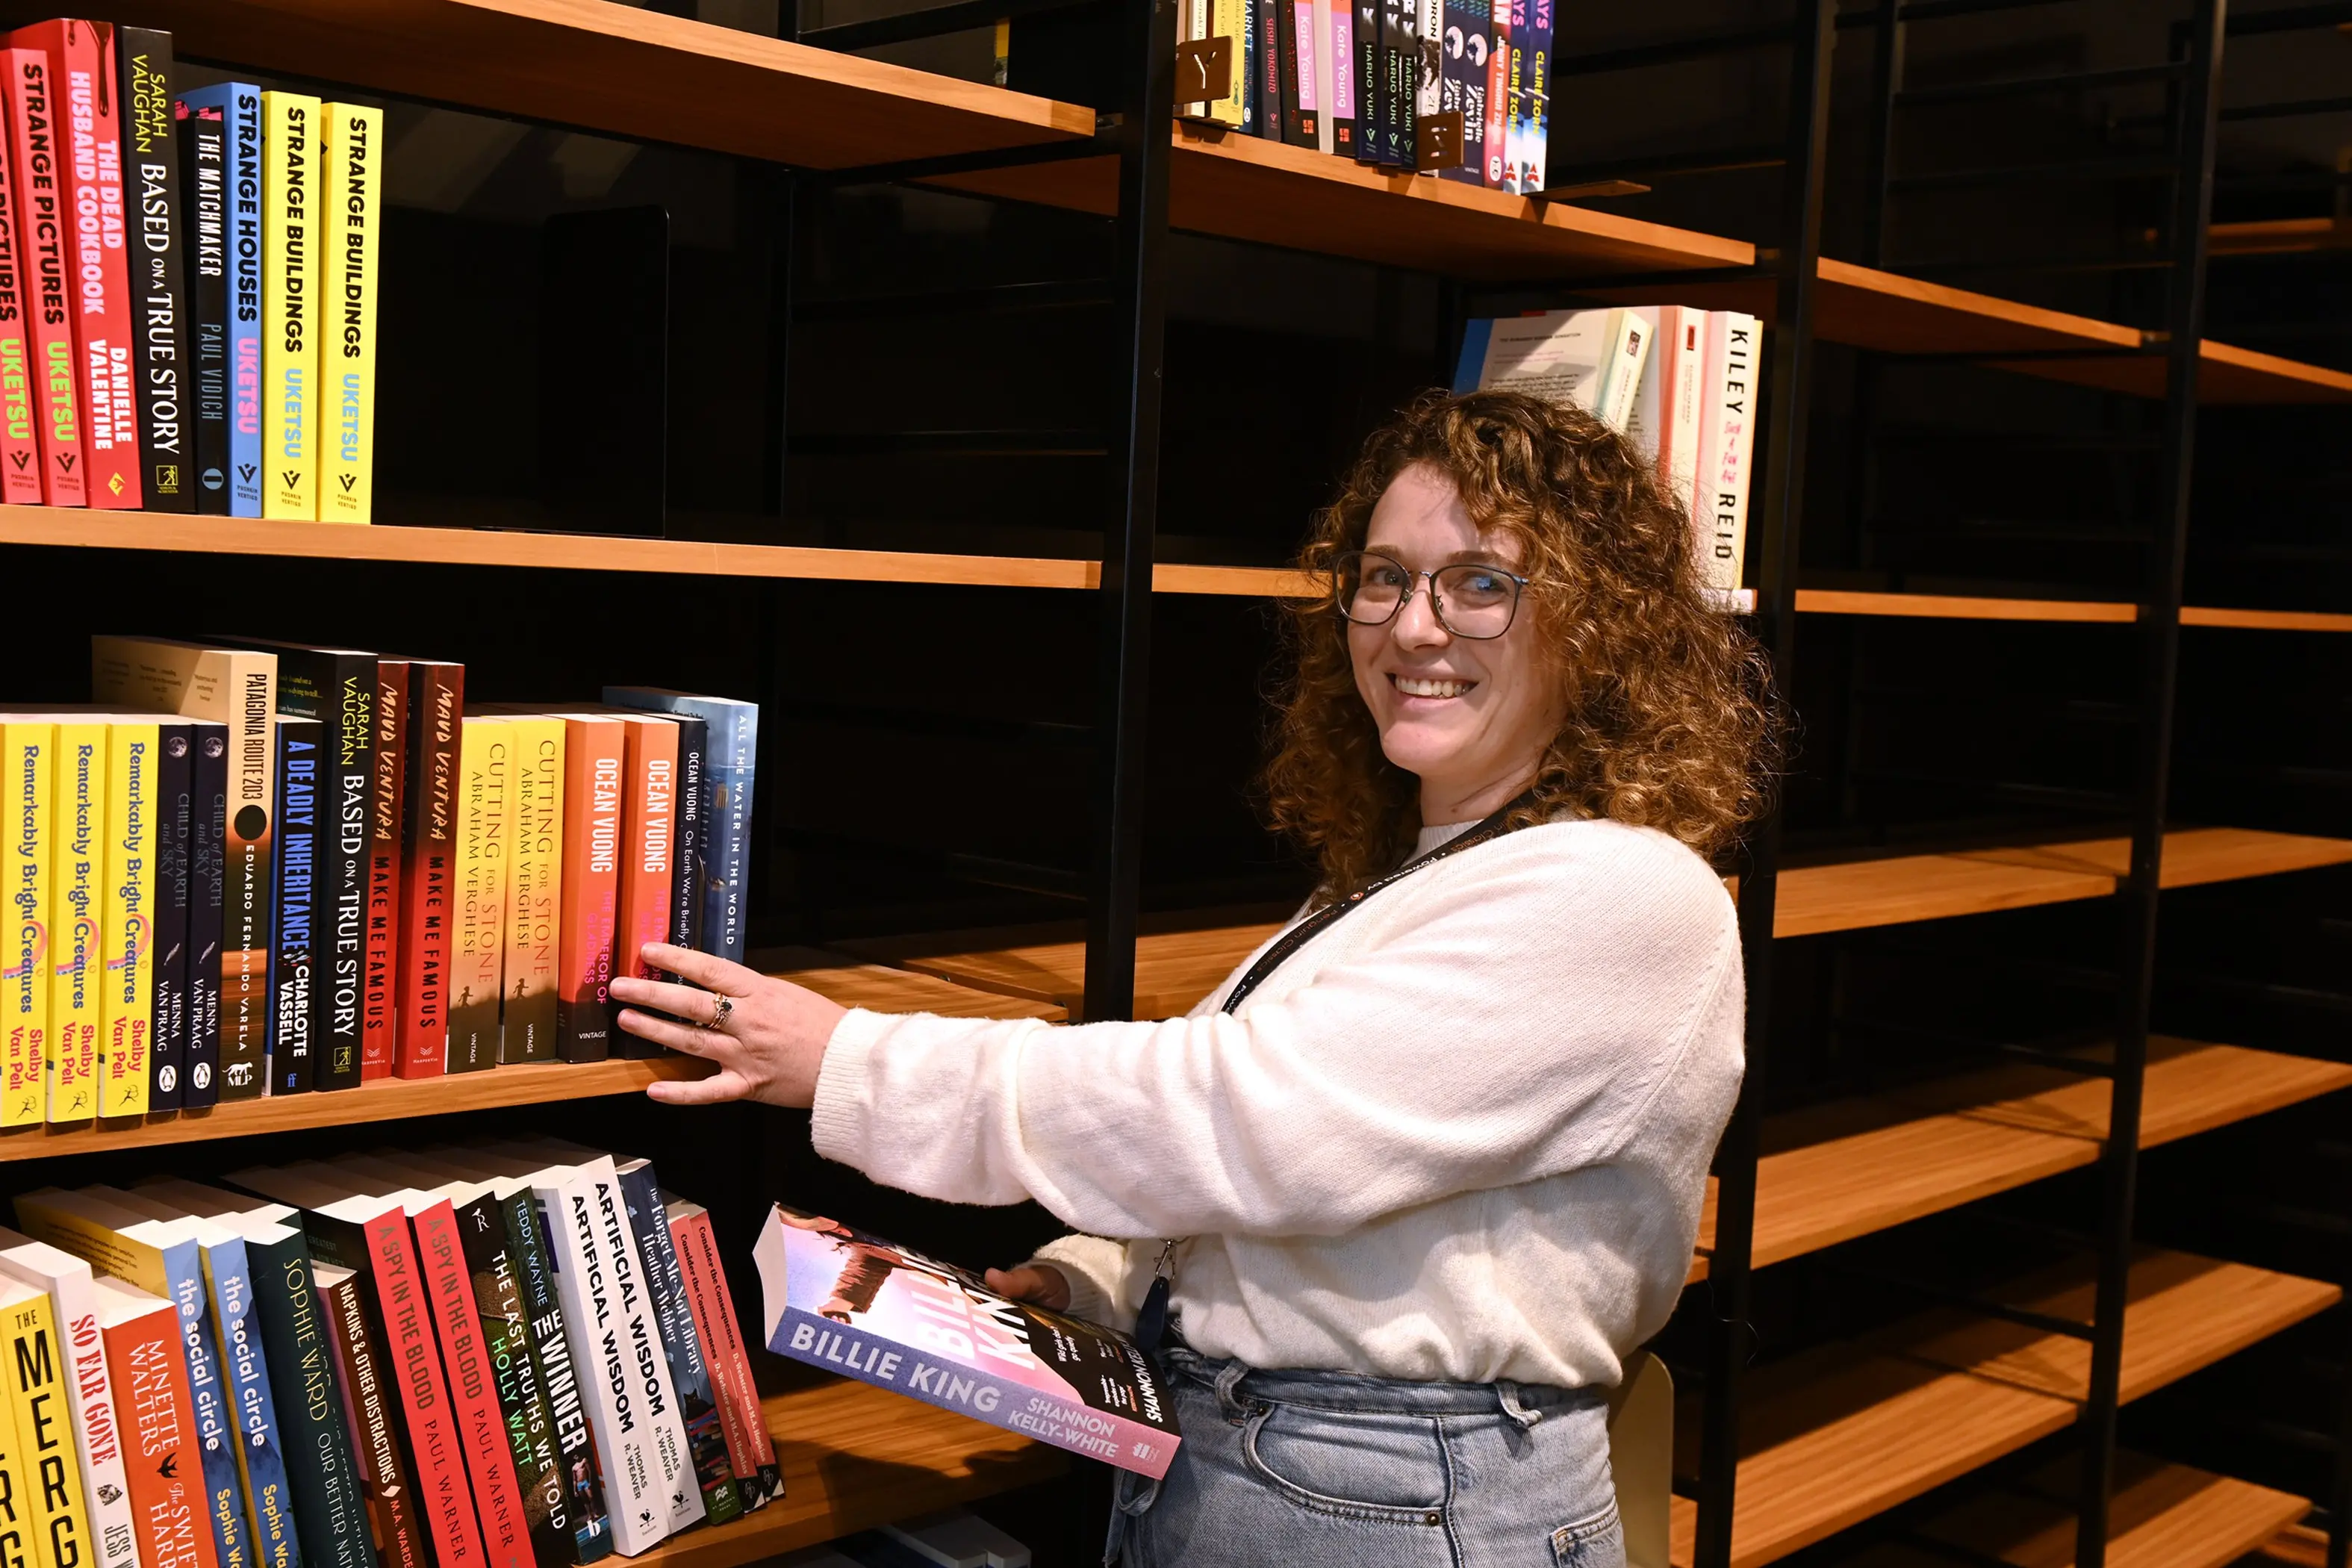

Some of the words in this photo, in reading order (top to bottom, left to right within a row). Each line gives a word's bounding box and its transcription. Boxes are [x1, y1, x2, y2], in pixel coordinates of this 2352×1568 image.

[1337, 25, 1347, 59] Kate
[1192, 52, 1217, 90] Y
[1337, 63, 1348, 108] Young
[1534, 51, 1546, 96] CLAIRE
[23, 63, 52, 190] STRANGE
[70, 71, 96, 181] HUSBAND
[132, 54, 152, 154] VAUGHAN
[150, 73, 168, 138] SARAH
[1474, 85, 1484, 143] Gabrielle
[97, 140, 119, 183] THE
[237, 93, 258, 214] STRANGE
[347, 116, 367, 228] STRANGE
[100, 187, 123, 249] DEAD
[140, 163, 170, 253] BASED
[34, 196, 65, 326] PICTURES
[77, 185, 105, 315] COOKBOOK
[151, 258, 165, 279] ON
[237, 219, 258, 322] HOUSES
[152, 280, 164, 290] A
[343, 232, 364, 358] BUILDINGS
[146, 292, 176, 361] TRUE
[1726, 329, 1749, 414] KILEY
[150, 368, 180, 455] STORY
[340, 373, 360, 462] UKETSU
[1715, 494, 1737, 560] REID
[244, 673, 267, 735] PATAGONIA
[436, 683, 455, 743] MAUD
[738, 715, 747, 741] ALL
[243, 738, 265, 776] ROUTE
[287, 740, 316, 753] A
[688, 752, 699, 783] OCEAN
[735, 747, 746, 775] THE
[123, 741, 146, 852] Remarkably
[241, 778, 264, 800] 203
[286, 759, 316, 827] DEADLY
[429, 751, 452, 840] VENTURA
[519, 768, 534, 855] ABRAHAM
[536, 740, 556, 853] CUTTING
[593, 757, 618, 813] OCEAN
[685, 786, 697, 821] VUONG
[732, 782, 744, 830] WATER
[198, 823, 209, 845] and
[212, 793, 225, 839] CHILD
[685, 830, 694, 846] On
[195, 849, 210, 877] SKY
[211, 842, 221, 854] of
[591, 816, 617, 874] VUONG
[682, 849, 693, 874] Earth
[729, 859, 739, 887] THE
[731, 838, 740, 852] IN
[119, 857, 142, 913] Bright
[209, 858, 223, 907] EARTH
[243, 844, 255, 909] EDUARDO
[282, 833, 314, 951] INHERITANCE
[426, 856, 444, 908] MAKE
[538, 863, 549, 889] FOR
[600, 890, 612, 914] THE
[681, 877, 692, 907] We're
[423, 915, 441, 942] ME
[516, 861, 532, 950] VERGHESE
[677, 909, 689, 941] Briefly
[726, 892, 737, 945] WORLD
[123, 918, 140, 1004] Creatures
[240, 915, 252, 992] FERNANDO
[533, 897, 551, 976] STONE
[584, 912, 598, 984] GLADNESS
[597, 917, 612, 983] EMPEROR
[193, 978, 204, 1004] VAN
[205, 990, 217, 1036] MENNA
[279, 980, 294, 1045] VASSELL
[293, 965, 310, 1057] CHARLOTTE
[420, 950, 440, 1028] FAMOUS
[597, 987, 607, 1004] OF
[113, 1015, 127, 1048] Van
[127, 1019, 146, 1072] Shelby
[191, 1007, 203, 1049] PRAAG
[238, 997, 249, 1051] VARELA
[112, 1051, 126, 1080] Pelt
[427, 1218, 446, 1233] A
[431, 1233, 455, 1272] SPY
[440, 1272, 461, 1297] IN
[491, 1249, 514, 1292] THE
[642, 1233, 665, 1289] Heather
[656, 1289, 677, 1343] Webber
[650, 1203, 688, 1313] Forget-Me-Not
[679, 1315, 702, 1375] Library
[14, 1309, 37, 1330] THE
[284, 1257, 316, 1348] SOPHIE
[339, 1283, 364, 1342] NAPKINS
[446, 1294, 469, 1335] THE
[502, 1297, 526, 1348] LAST
[531, 1307, 564, 1340] THE
[595, 1183, 638, 1313] ARTIFICIAL
[629, 1313, 667, 1417] WISDOM
[69, 1313, 98, 1347] SO
[231, 1318, 260, 1384] social
[352, 1341, 366, 1354] &
[699, 1225, 714, 1268] Consider
[710, 1266, 719, 1284] the
[715, 1284, 736, 1350] Consequences
[732, 1352, 738, 1363] D.
[735, 1362, 747, 1396] Webster
[744, 1395, 753, 1411] and
[753, 1429, 766, 1463] Hopkins
[76, 1349, 106, 1400] FAR
[301, 1348, 328, 1421] WARD
[355, 1354, 376, 1396] OTHER
[454, 1334, 484, 1401] BLOOD
[515, 1352, 545, 1434] TRUTHS
[540, 1331, 588, 1455] WINNER
[790, 1322, 903, 1381] BILLIE
[908, 1362, 1001, 1413] KING
[128, 1343, 161, 1457] WALTERS
[146, 1340, 181, 1452] MINETTE
[243, 1387, 270, 1447] circle
[491, 1337, 520, 1403] HOLLY
[508, 1408, 533, 1466] WATT
[1027, 1396, 1116, 1438] SHANNON
[84, 1402, 117, 1466] GONE
[317, 1433, 336, 1474] OUR
[364, 1394, 396, 1484] DISTRACTIONS
[473, 1409, 494, 1460] PAUL
[535, 1437, 555, 1472] WE
[1008, 1410, 1120, 1458] KELLY-WHITE
[263, 1484, 284, 1540] Sophie
[325, 1476, 346, 1535] BETTER
[391, 1499, 404, 1528] M.A.
[486, 1463, 514, 1549] WARNER
[543, 1475, 566, 1530] TOLD
